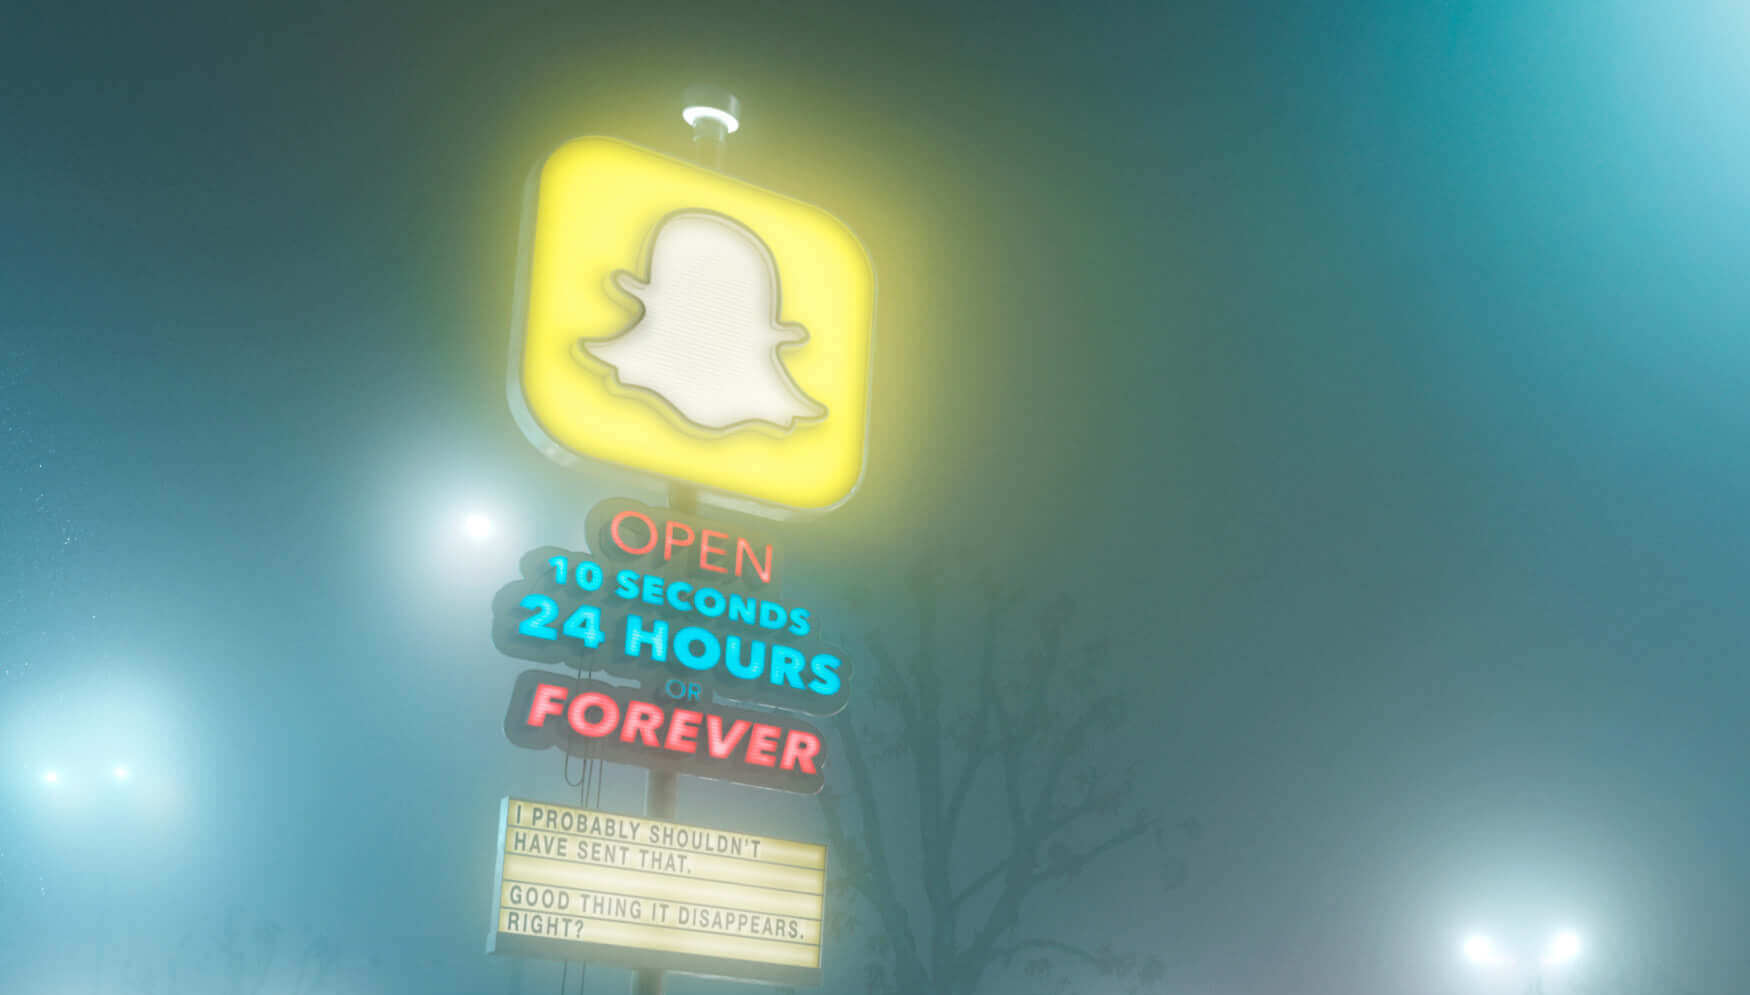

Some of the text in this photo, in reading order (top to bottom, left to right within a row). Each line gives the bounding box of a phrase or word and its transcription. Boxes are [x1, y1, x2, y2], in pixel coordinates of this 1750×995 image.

[611, 511, 773, 583] OPEN
[549, 556, 811, 636] 10 SECONDS
[519, 594, 842, 696] 24 HOURS
[665, 679, 702, 703] OR
[526, 684, 821, 775] FOREVER
[513, 832, 692, 874] HAVE SENT THAT.
[516, 805, 761, 859] I PROBABLY SHOULDN'T
[507, 912, 585, 938] RIGHT?
[509, 885, 805, 940] GOOD THING IT DISAPPEARS.
